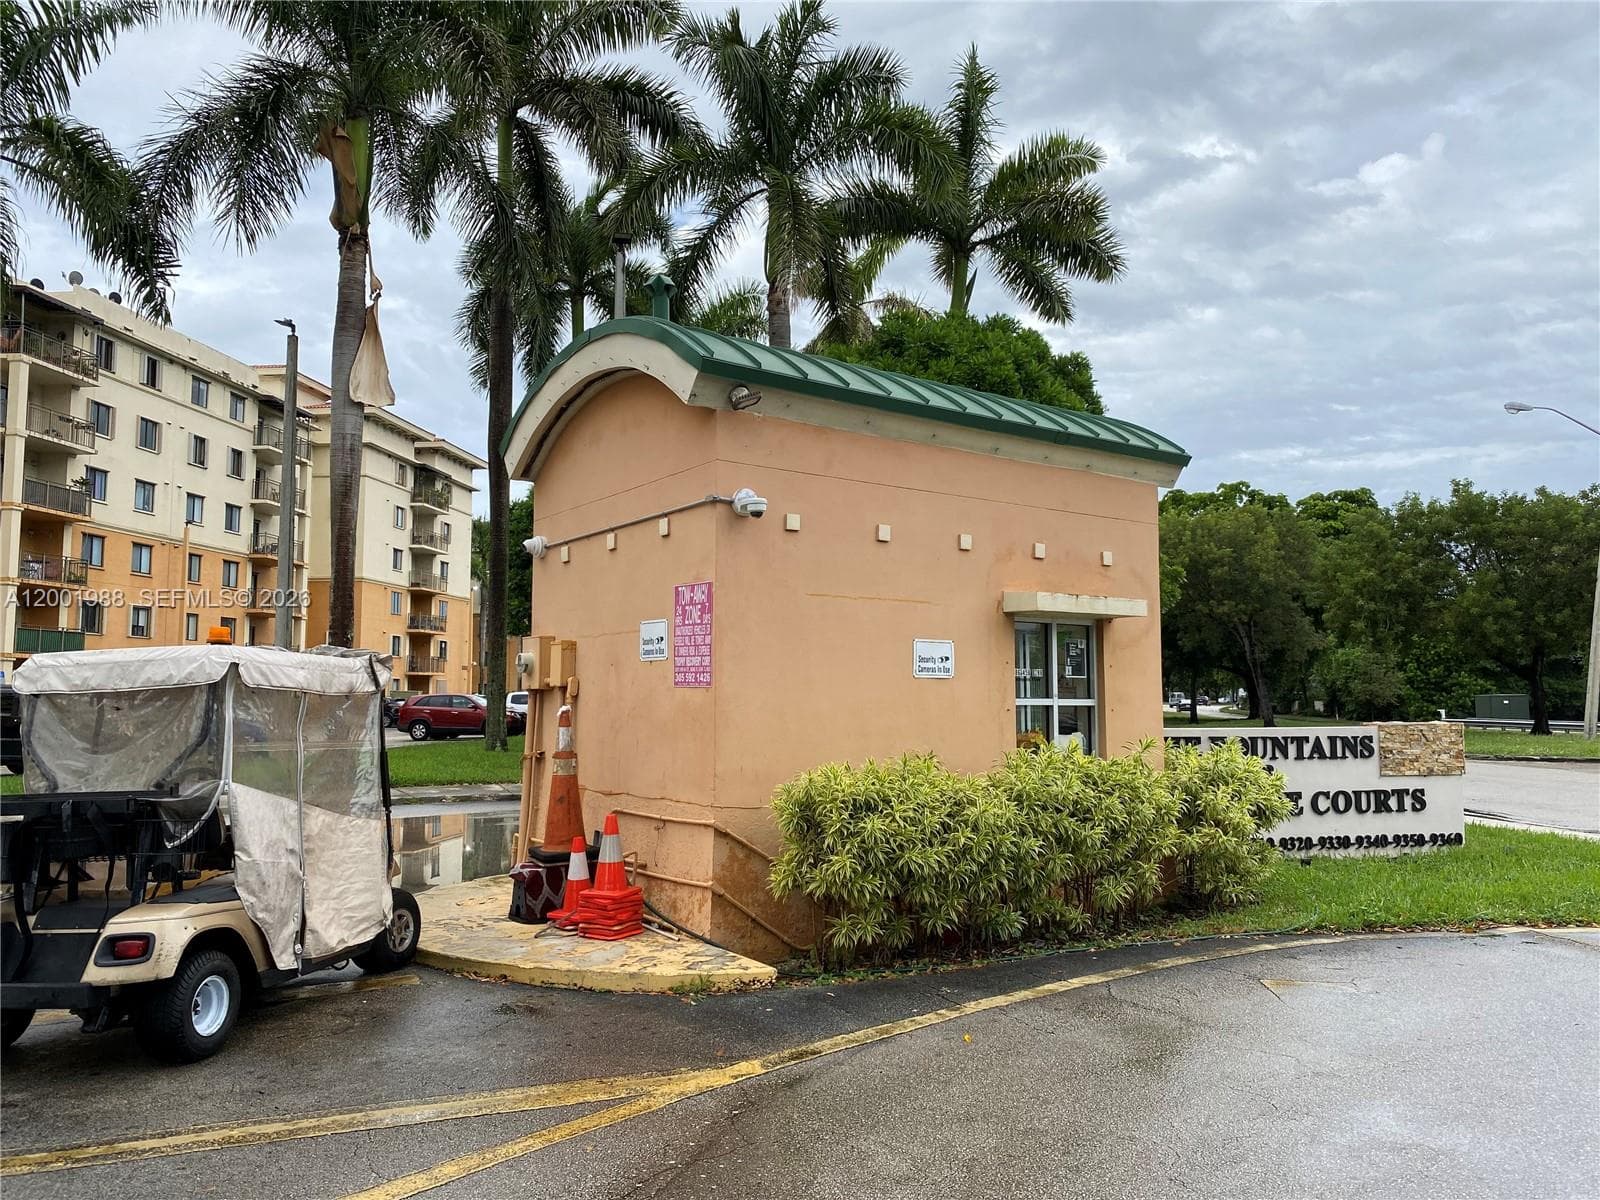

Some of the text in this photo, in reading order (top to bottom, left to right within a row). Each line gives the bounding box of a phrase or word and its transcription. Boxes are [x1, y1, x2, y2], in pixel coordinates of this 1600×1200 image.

[678, 583, 709, 605] TOW-AWAY
[685, 605, 701, 624] ZONE
[642, 638, 654, 647] Security
[918, 655, 936, 665] Security
[918, 665, 936, 673] Cameras
[675, 672, 711, 682] 305 592 1426
[1311, 788, 1428, 815] COURTS
